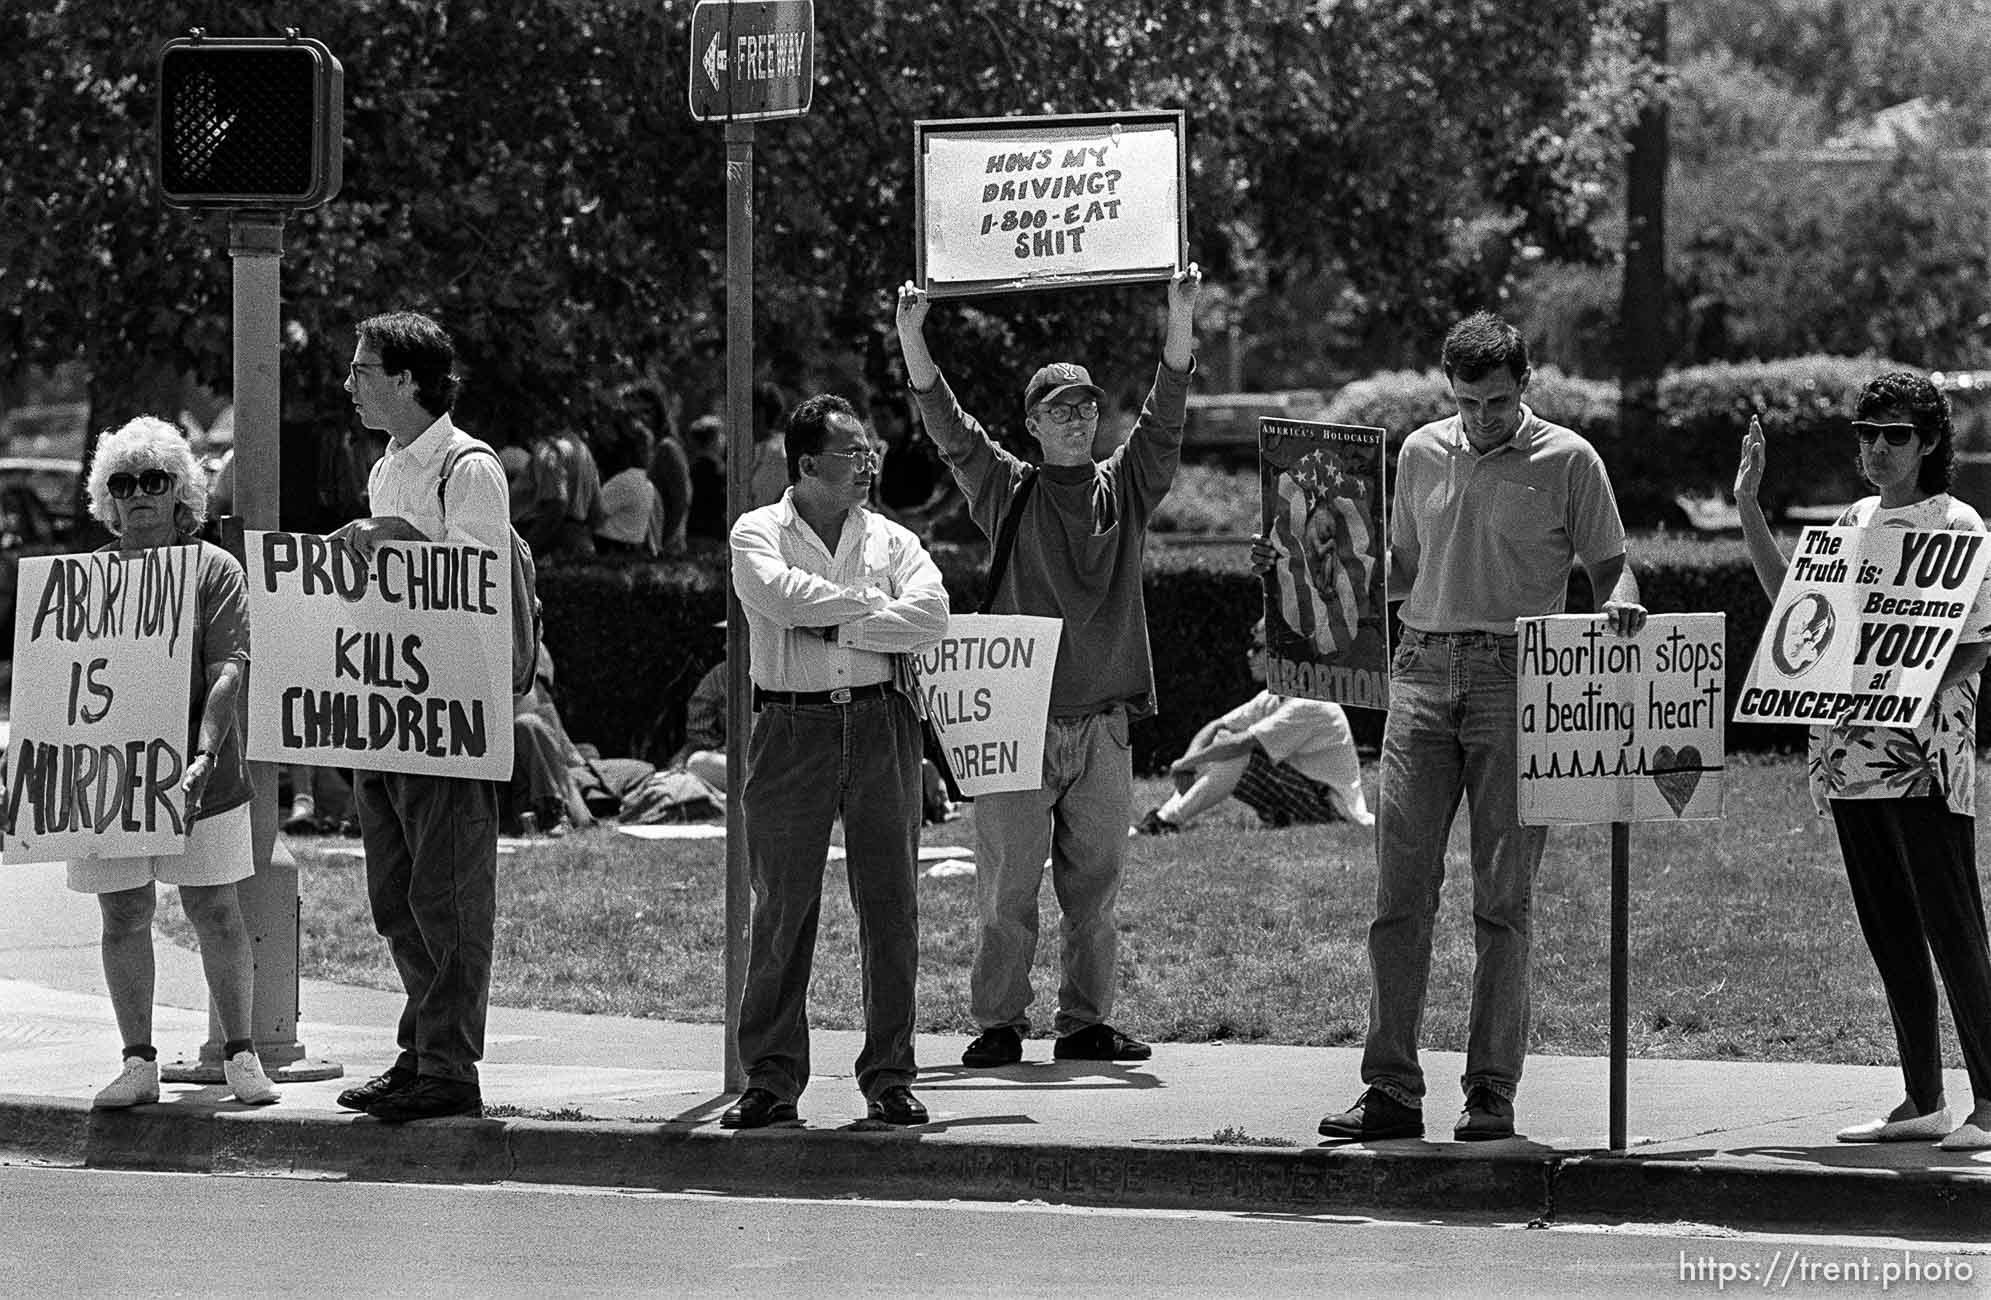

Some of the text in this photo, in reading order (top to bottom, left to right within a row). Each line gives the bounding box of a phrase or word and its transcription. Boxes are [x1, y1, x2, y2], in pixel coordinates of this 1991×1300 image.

[737, 31, 805, 80] FREEWAY
[985, 146, 1108, 174] HOW'S MY
[982, 169, 1121, 203] DRIVING?
[981, 199, 1121, 235] 1-800-EAT
[1014, 225, 1085, 259] SHIT
[1262, 424, 1380, 444] AMERICA'S HOLOCAUST
[1805, 530, 1843, 555] The
[1892, 532, 1984, 590] YOU
[262, 532, 498, 615] PRO-CHOICE
[1794, 557, 1883, 584] Truth is:
[1863, 592, 1965, 618] Became
[335, 627, 429, 694] KILLS
[1522, 620, 1723, 688] Abortion stops
[1853, 622, 1954, 670] YOU!
[68, 658, 114, 725] IS
[1268, 657, 1389, 707] ABORTION
[1868, 670, 1892, 690] at
[281, 687, 487, 757] CHILDREN
[1522, 678, 1721, 746] a beating heart
[1740, 687, 1922, 723] CONCEPTION
[7, 738, 184, 836] MURDER
